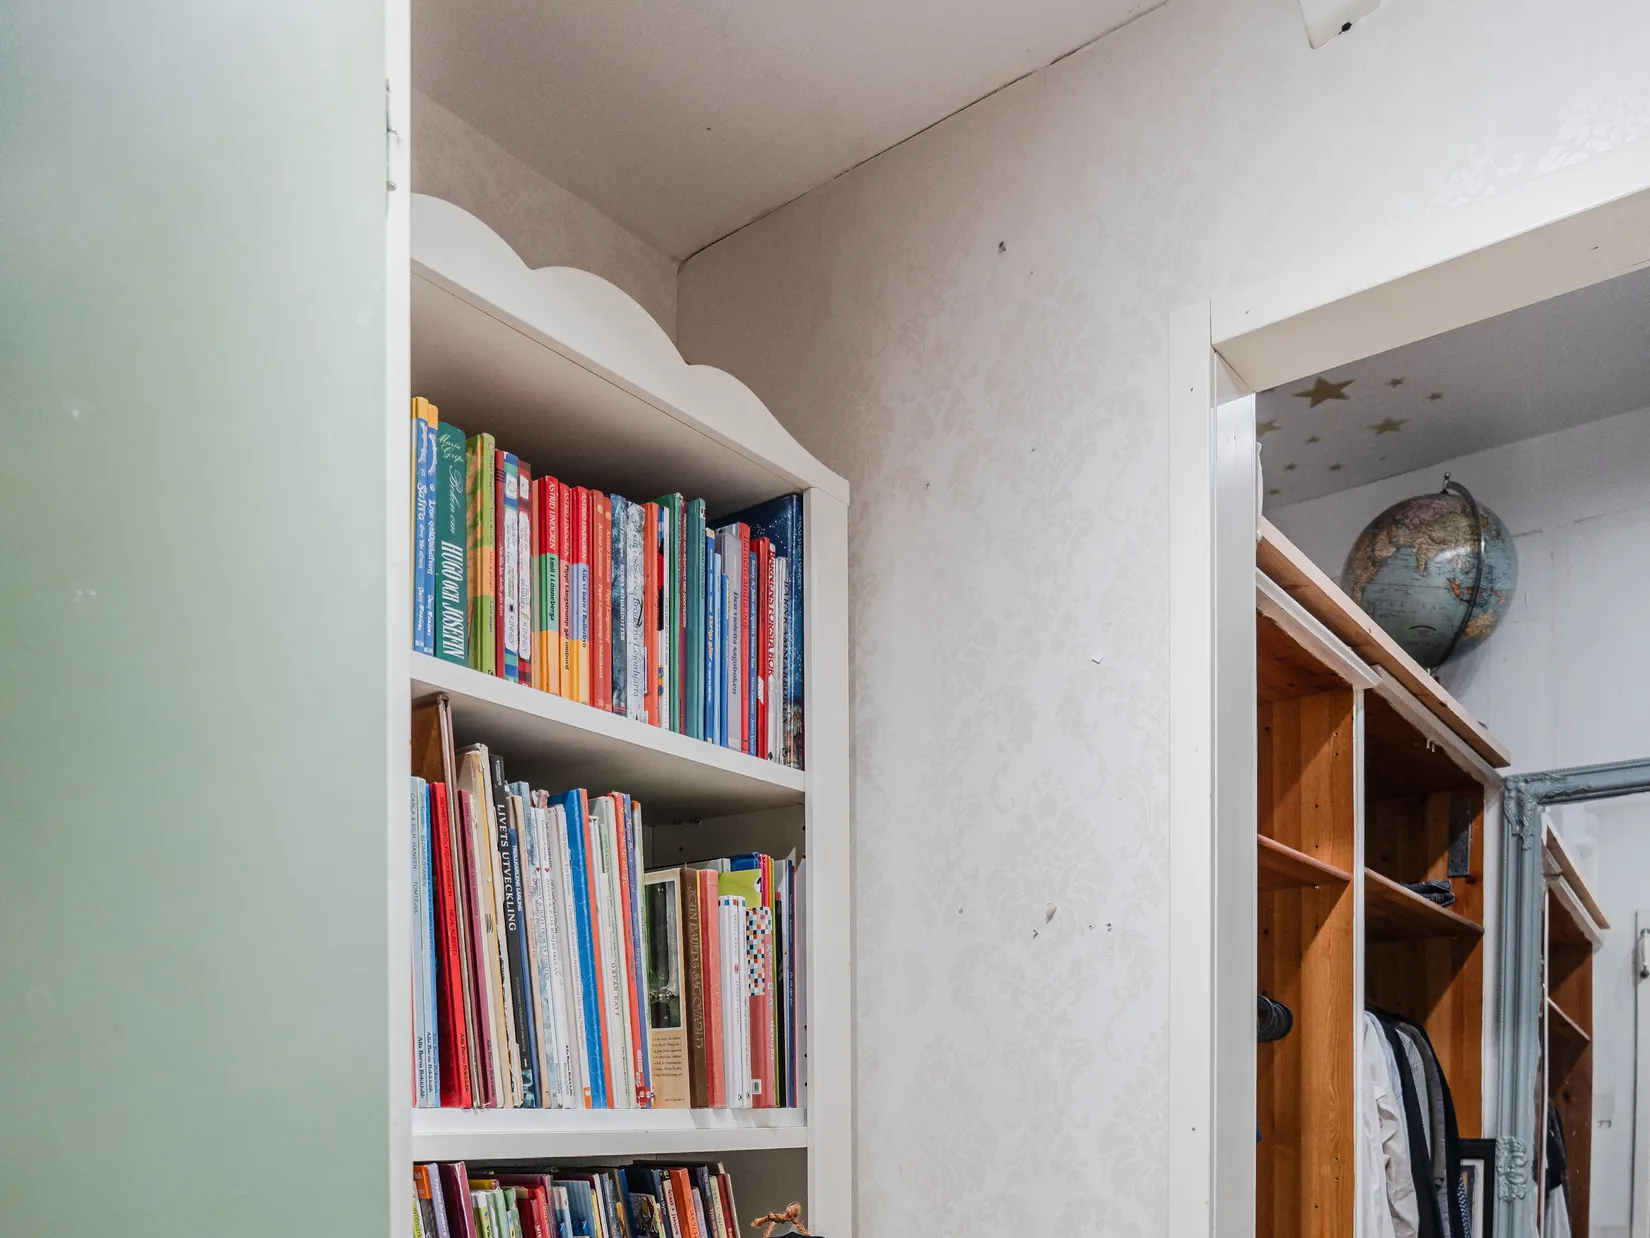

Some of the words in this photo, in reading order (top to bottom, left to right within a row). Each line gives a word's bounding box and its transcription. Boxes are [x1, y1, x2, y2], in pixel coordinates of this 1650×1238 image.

[439, 433, 461, 450] Maria
[448, 465, 464, 514] Boken
[449, 514, 456, 535] om
[441, 540, 464, 582] HUGO
[768, 549, 776, 605] BARNENS
[442, 580, 460, 601] OCH
[548, 578, 556, 621] Lönneberga
[441, 602, 466, 659] JOSEFIN
[768, 607, 776, 649] FÖRSTA
[631, 643, 640, 698] Lejonhjärta
[731, 646, 739, 695] sagoboken
[768, 651, 776, 677] BOK
[497, 804, 509, 847] LIVETS
[512, 844, 521, 887] TROLLKARLENS
[501, 851, 517, 932] UTVECKLING
[515, 888, 523, 912] LÄRLING
[688, 886, 698, 920] JOHN
[690, 922, 700, 969] BAUERS
[610, 962, 618, 992] OSKAR
[436, 1203, 450, 1237] Granberg
[687, 1197, 693, 1207] NU
